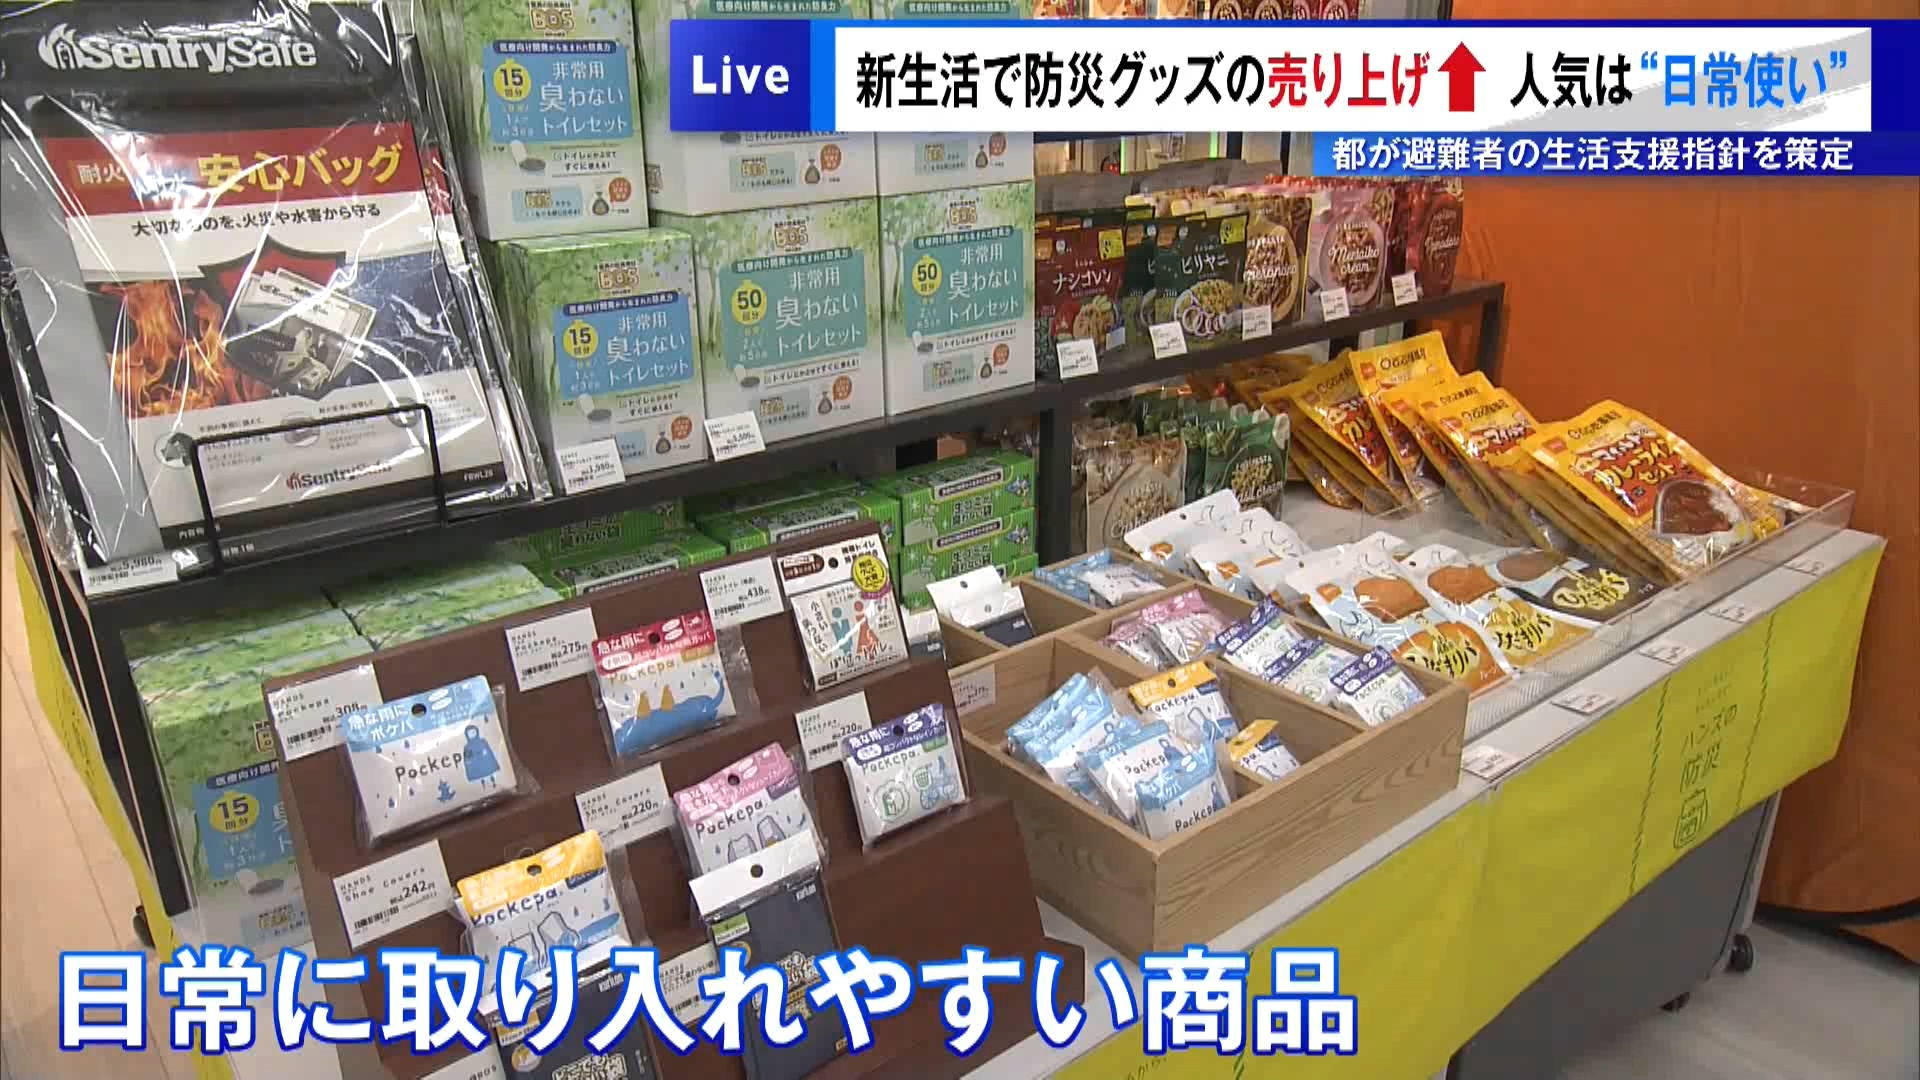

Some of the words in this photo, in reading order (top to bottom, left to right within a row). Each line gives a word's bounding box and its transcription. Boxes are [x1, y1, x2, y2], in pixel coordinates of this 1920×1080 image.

[78, 35, 317, 73] SentrySafe
[499, 68, 524, 87] 15
[552, 61, 605, 80] 非常用
[538, 82, 624, 113] 臭わない
[543, 115, 628, 137] トイレセット
[197, 143, 403, 193] 安心バッグ
[961, 244, 1003, 265] 非常用
[1181, 252, 1229, 275] ビリヤニ
[789, 266, 841, 291] 非常用
[917, 263, 938, 282] 50
[947, 269, 1018, 300] 臭わない
[1052, 268, 1112, 295] ナシゴレン
[737, 289, 762, 311] 50
[775, 293, 858, 331] 臭わない
[949, 295, 1019, 325] トイレセット
[618, 312, 668, 332] 非常用
[569, 328, 592, 346] 15
[606, 333, 686, 366] 臭わない
[777, 323, 862, 358] トイレセット
[607, 359, 690, 388] トイレセット
[1680, 741, 1721, 793] 防災
[217, 796, 250, 820] 15
[224, 817, 249, 831] 回分
